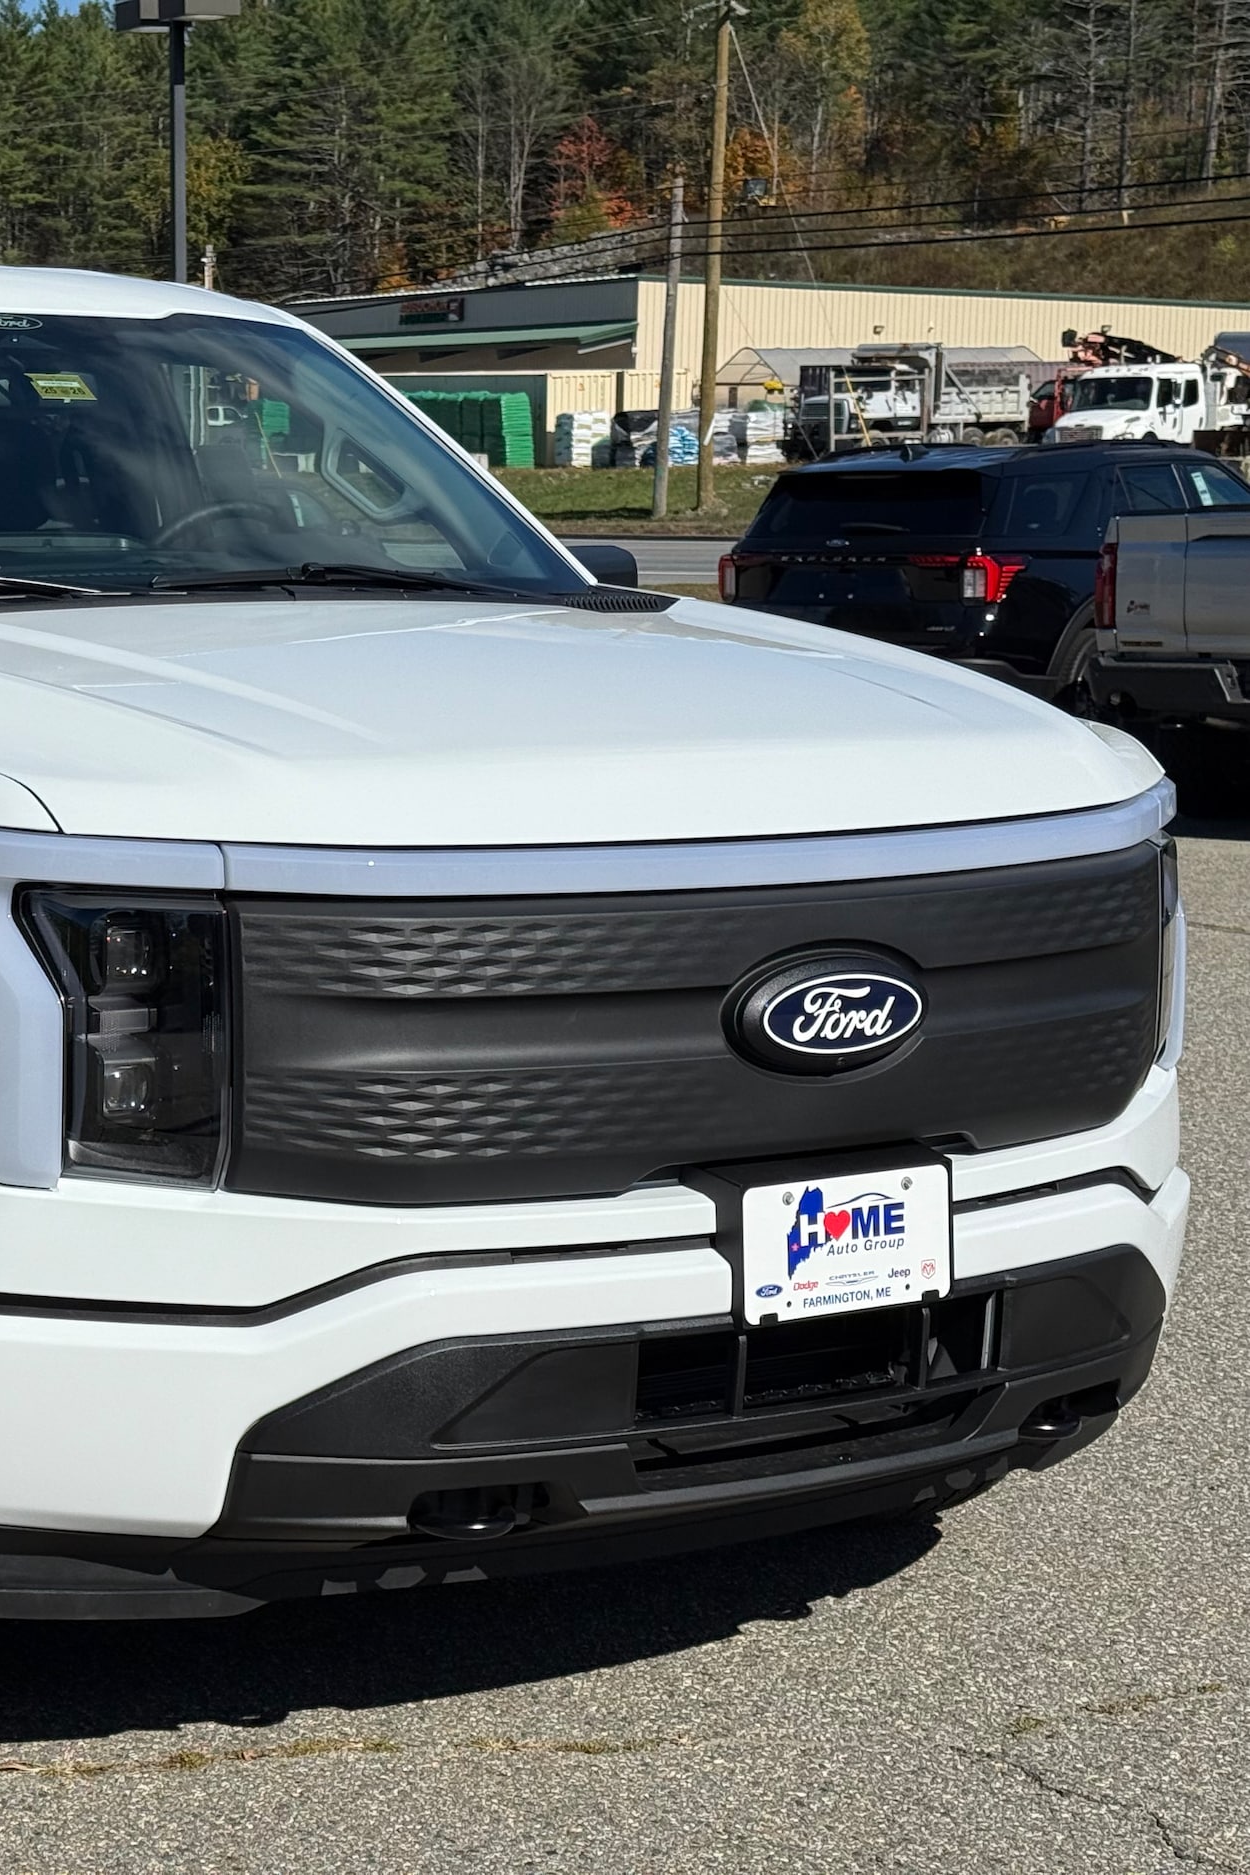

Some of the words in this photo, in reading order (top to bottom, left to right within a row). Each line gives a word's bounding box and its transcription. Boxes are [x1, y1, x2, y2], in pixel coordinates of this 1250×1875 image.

[792, 985, 896, 1043] Ford
[826, 1242, 858, 1257] Auto
[864, 1237, 905, 1251] Group
[887, 1267, 911, 1279] Jeep
[793, 1280, 819, 1292] Dodge
[803, 1289, 873, 1309] FARMINGTON,
[876, 1286, 892, 1299] ME
